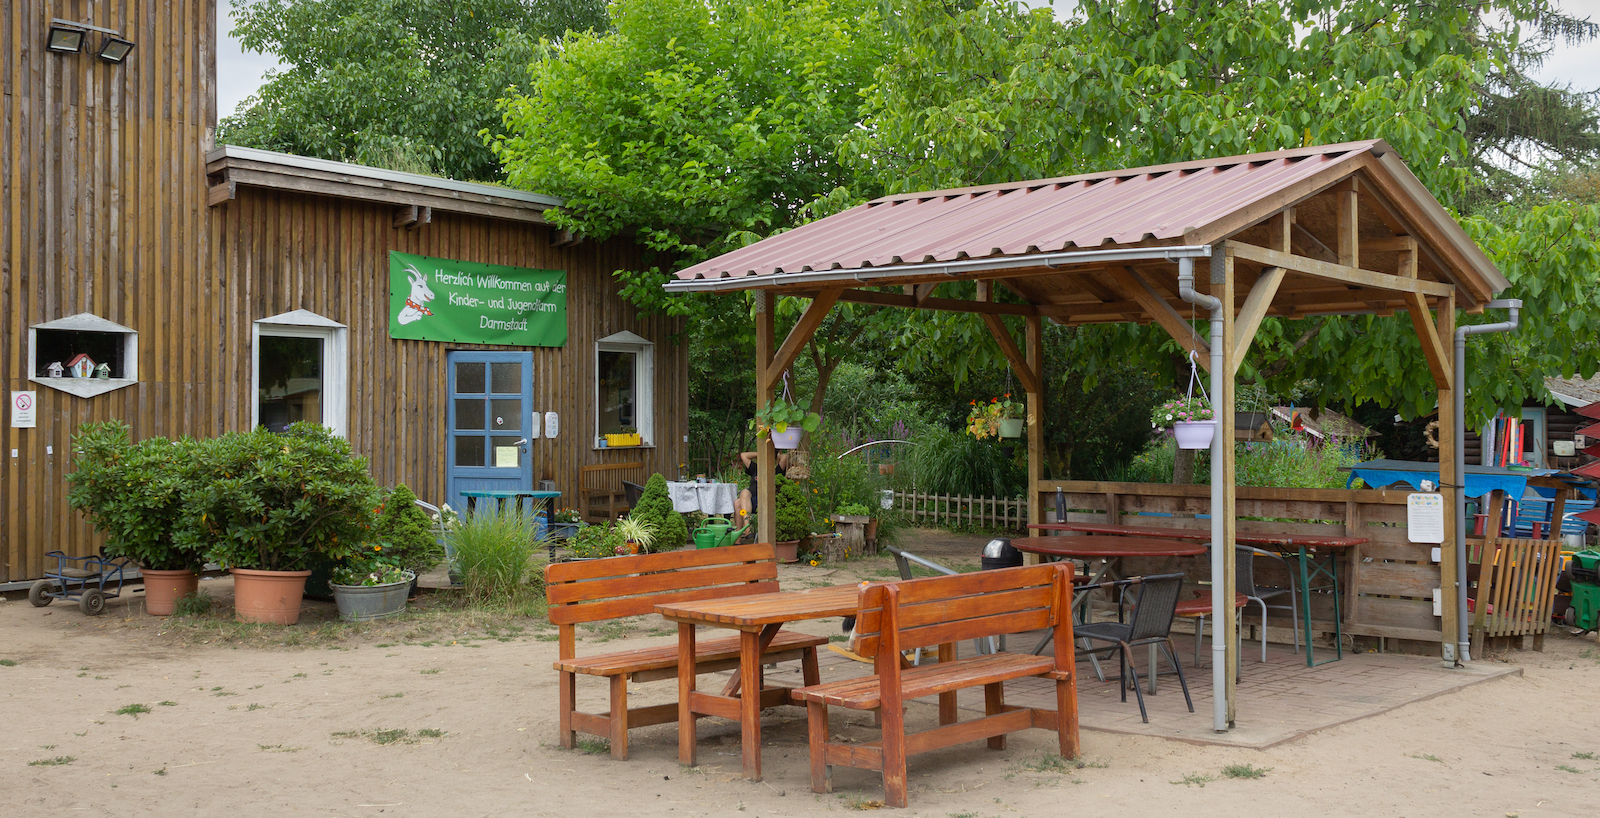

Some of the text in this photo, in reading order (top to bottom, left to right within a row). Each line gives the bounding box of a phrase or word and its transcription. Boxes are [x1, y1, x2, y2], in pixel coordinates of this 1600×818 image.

[435, 269, 566, 294] Herzlich Willkommen auf der
[449, 292, 557, 315] Kinder- und Jugendfarm
[480, 315, 528, 331] Darmstadt
